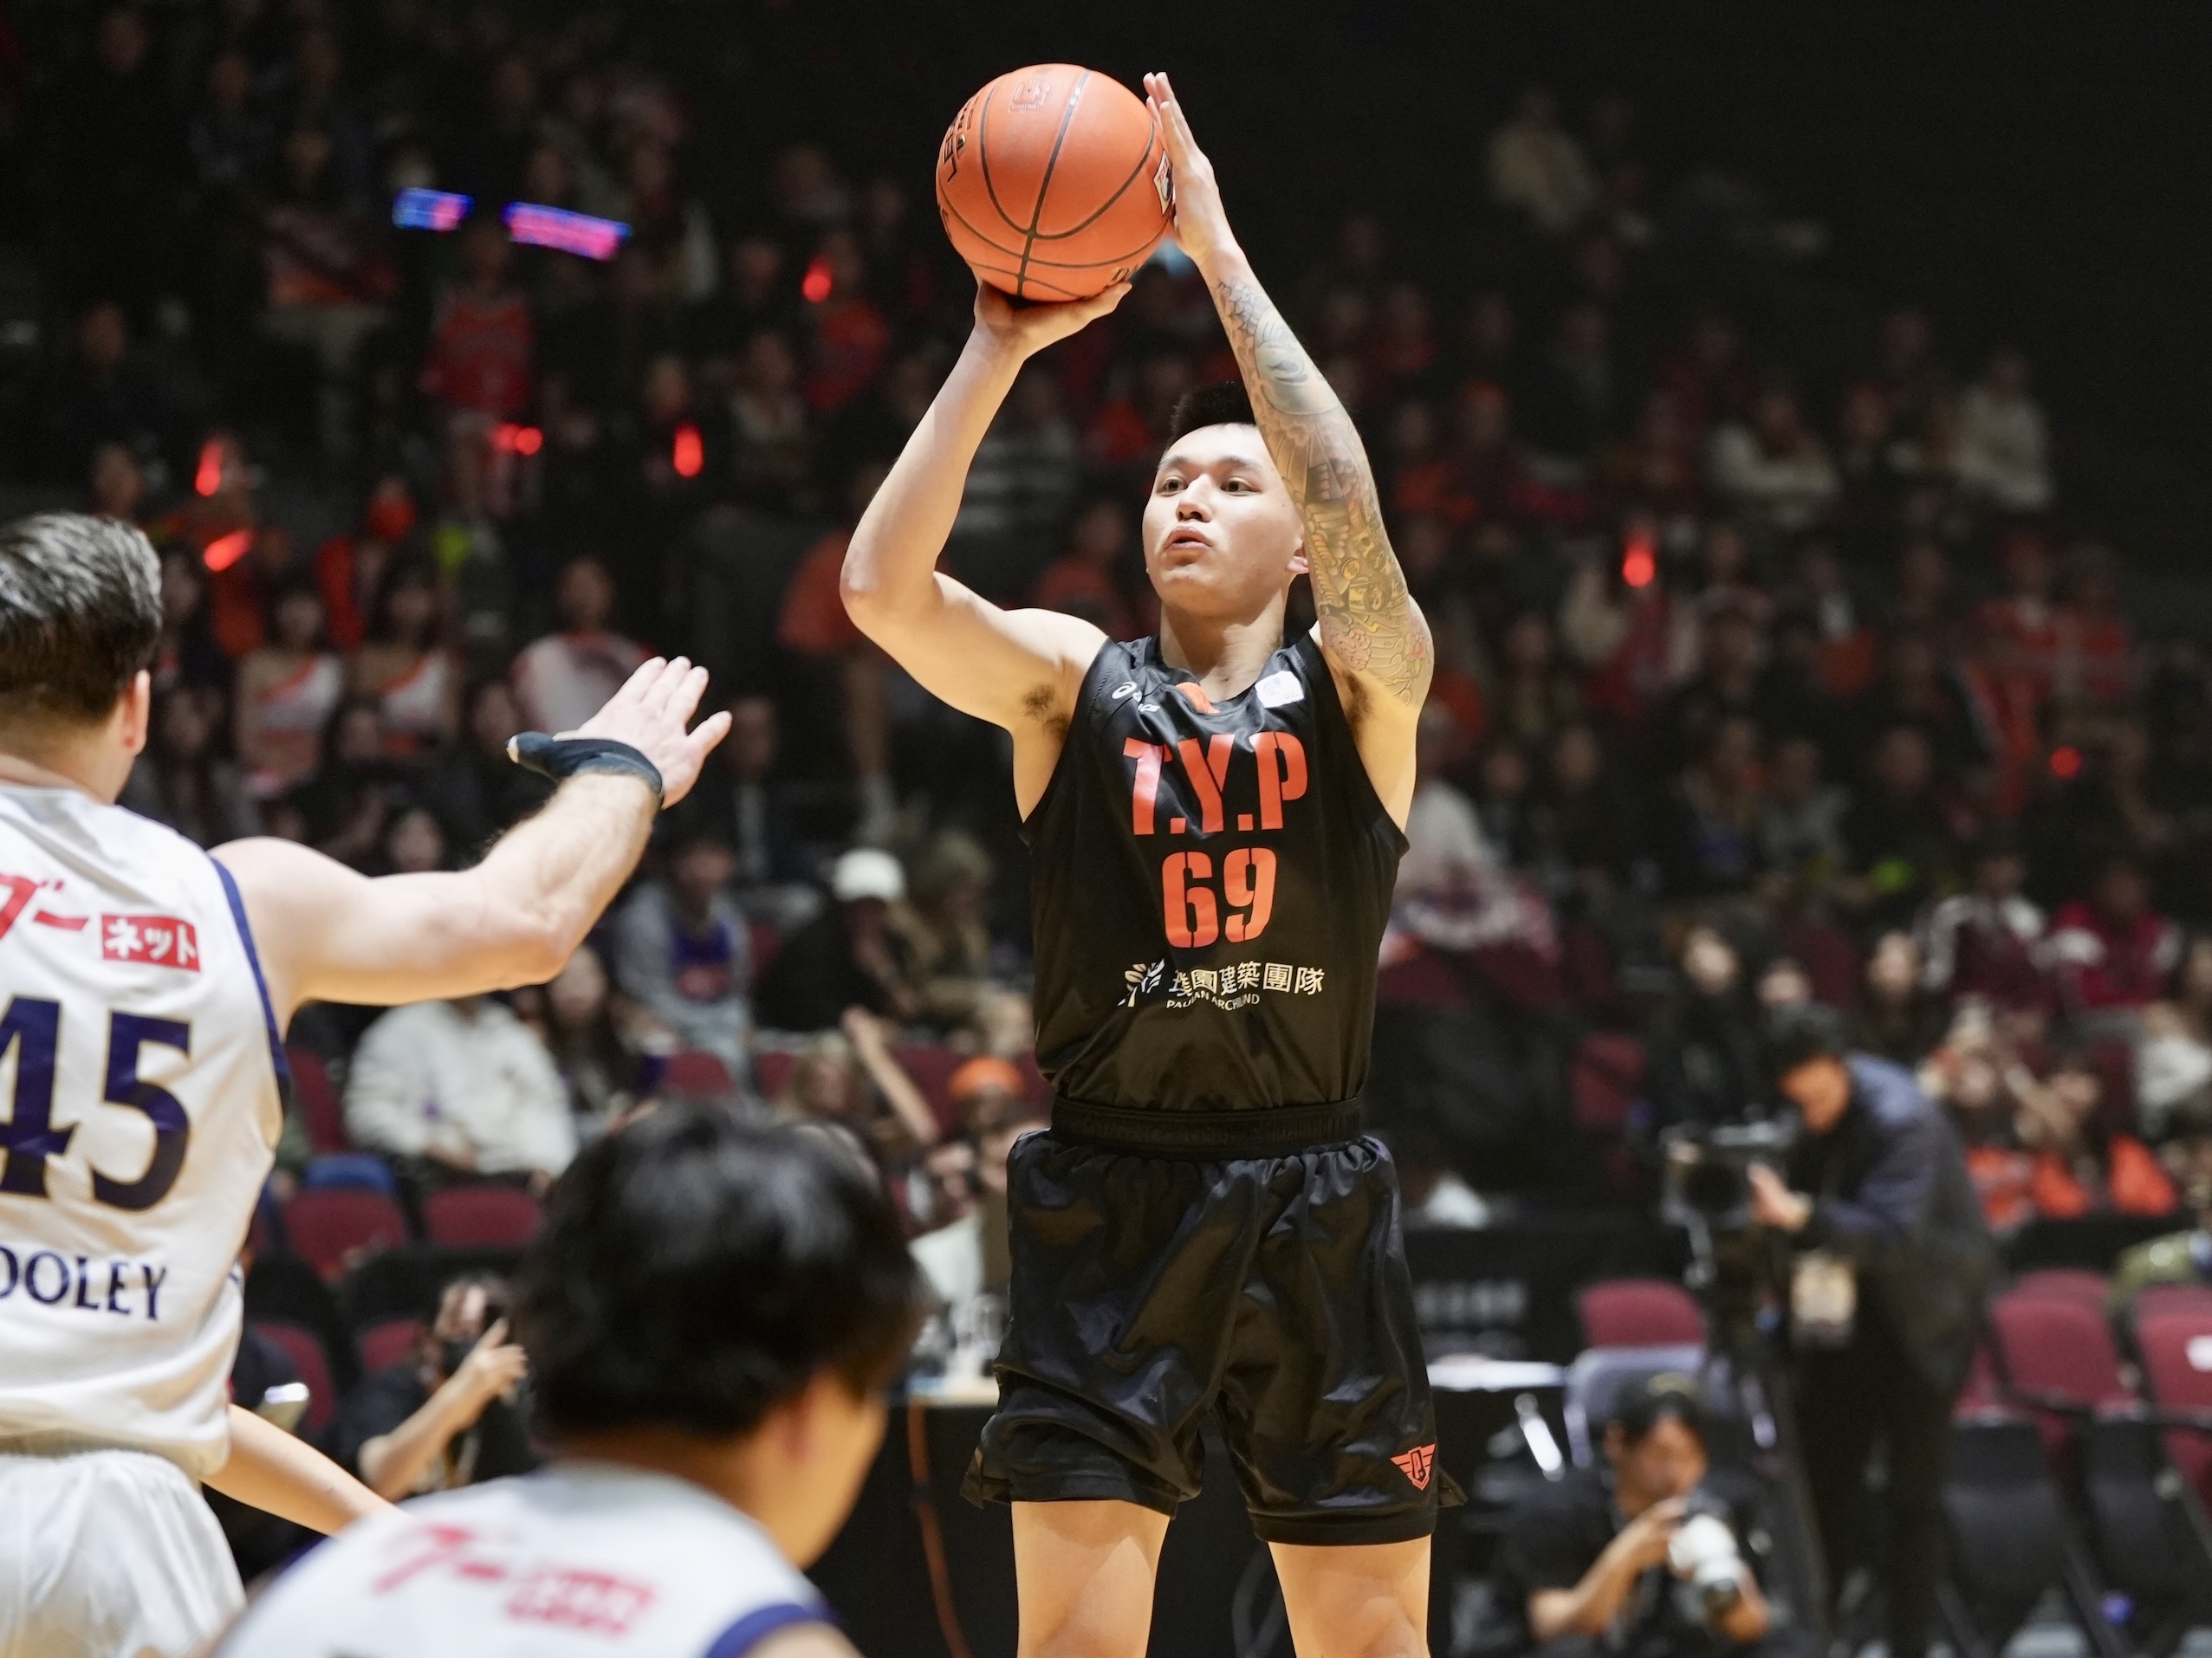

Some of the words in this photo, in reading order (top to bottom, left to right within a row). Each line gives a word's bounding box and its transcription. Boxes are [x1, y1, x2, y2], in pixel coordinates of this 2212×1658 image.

[1123, 731, 1307, 835] T.Y.P
[1161, 847, 1277, 948] 69
[0, 994, 192, 1211] 45
